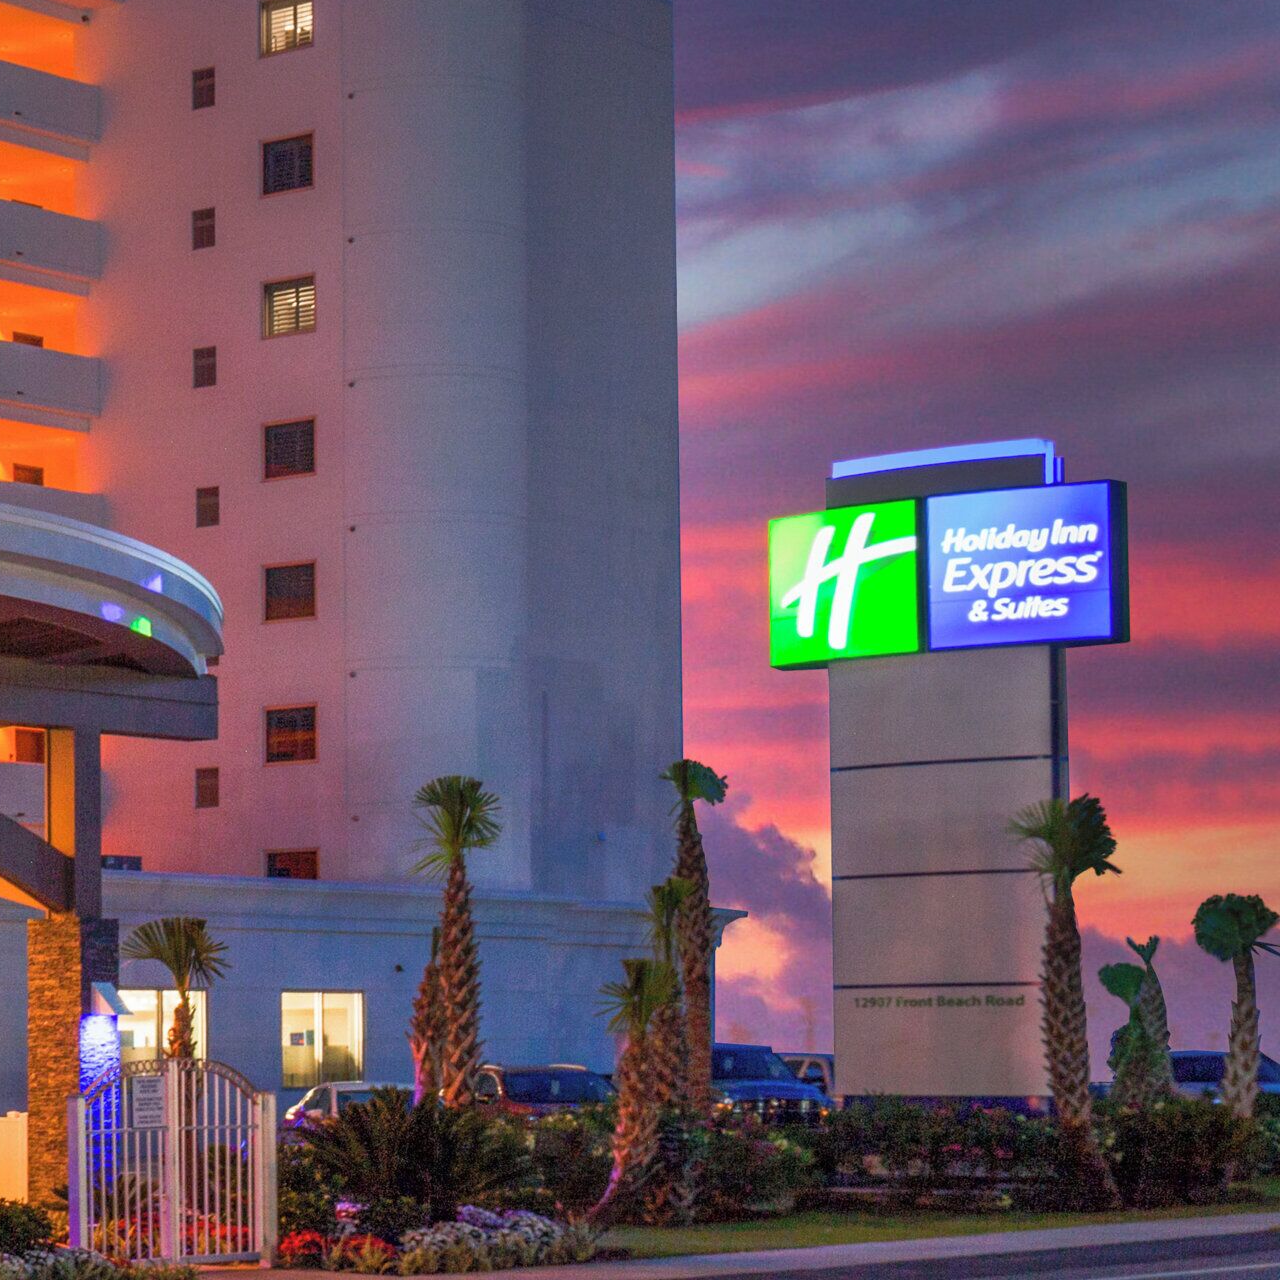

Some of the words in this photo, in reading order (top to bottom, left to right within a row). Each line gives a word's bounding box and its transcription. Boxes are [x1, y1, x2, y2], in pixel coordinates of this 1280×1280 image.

[940, 523, 1050, 554] Holiday
[1050, 518, 1099, 545] Inn
[942, 554, 1100, 598] Express
[967, 598, 989, 623] &
[990, 595, 1069, 621] Suites
[895, 995, 933, 1008] Front
[937, 994, 981, 1007] Beach
[985, 993, 1025, 1007] Road
